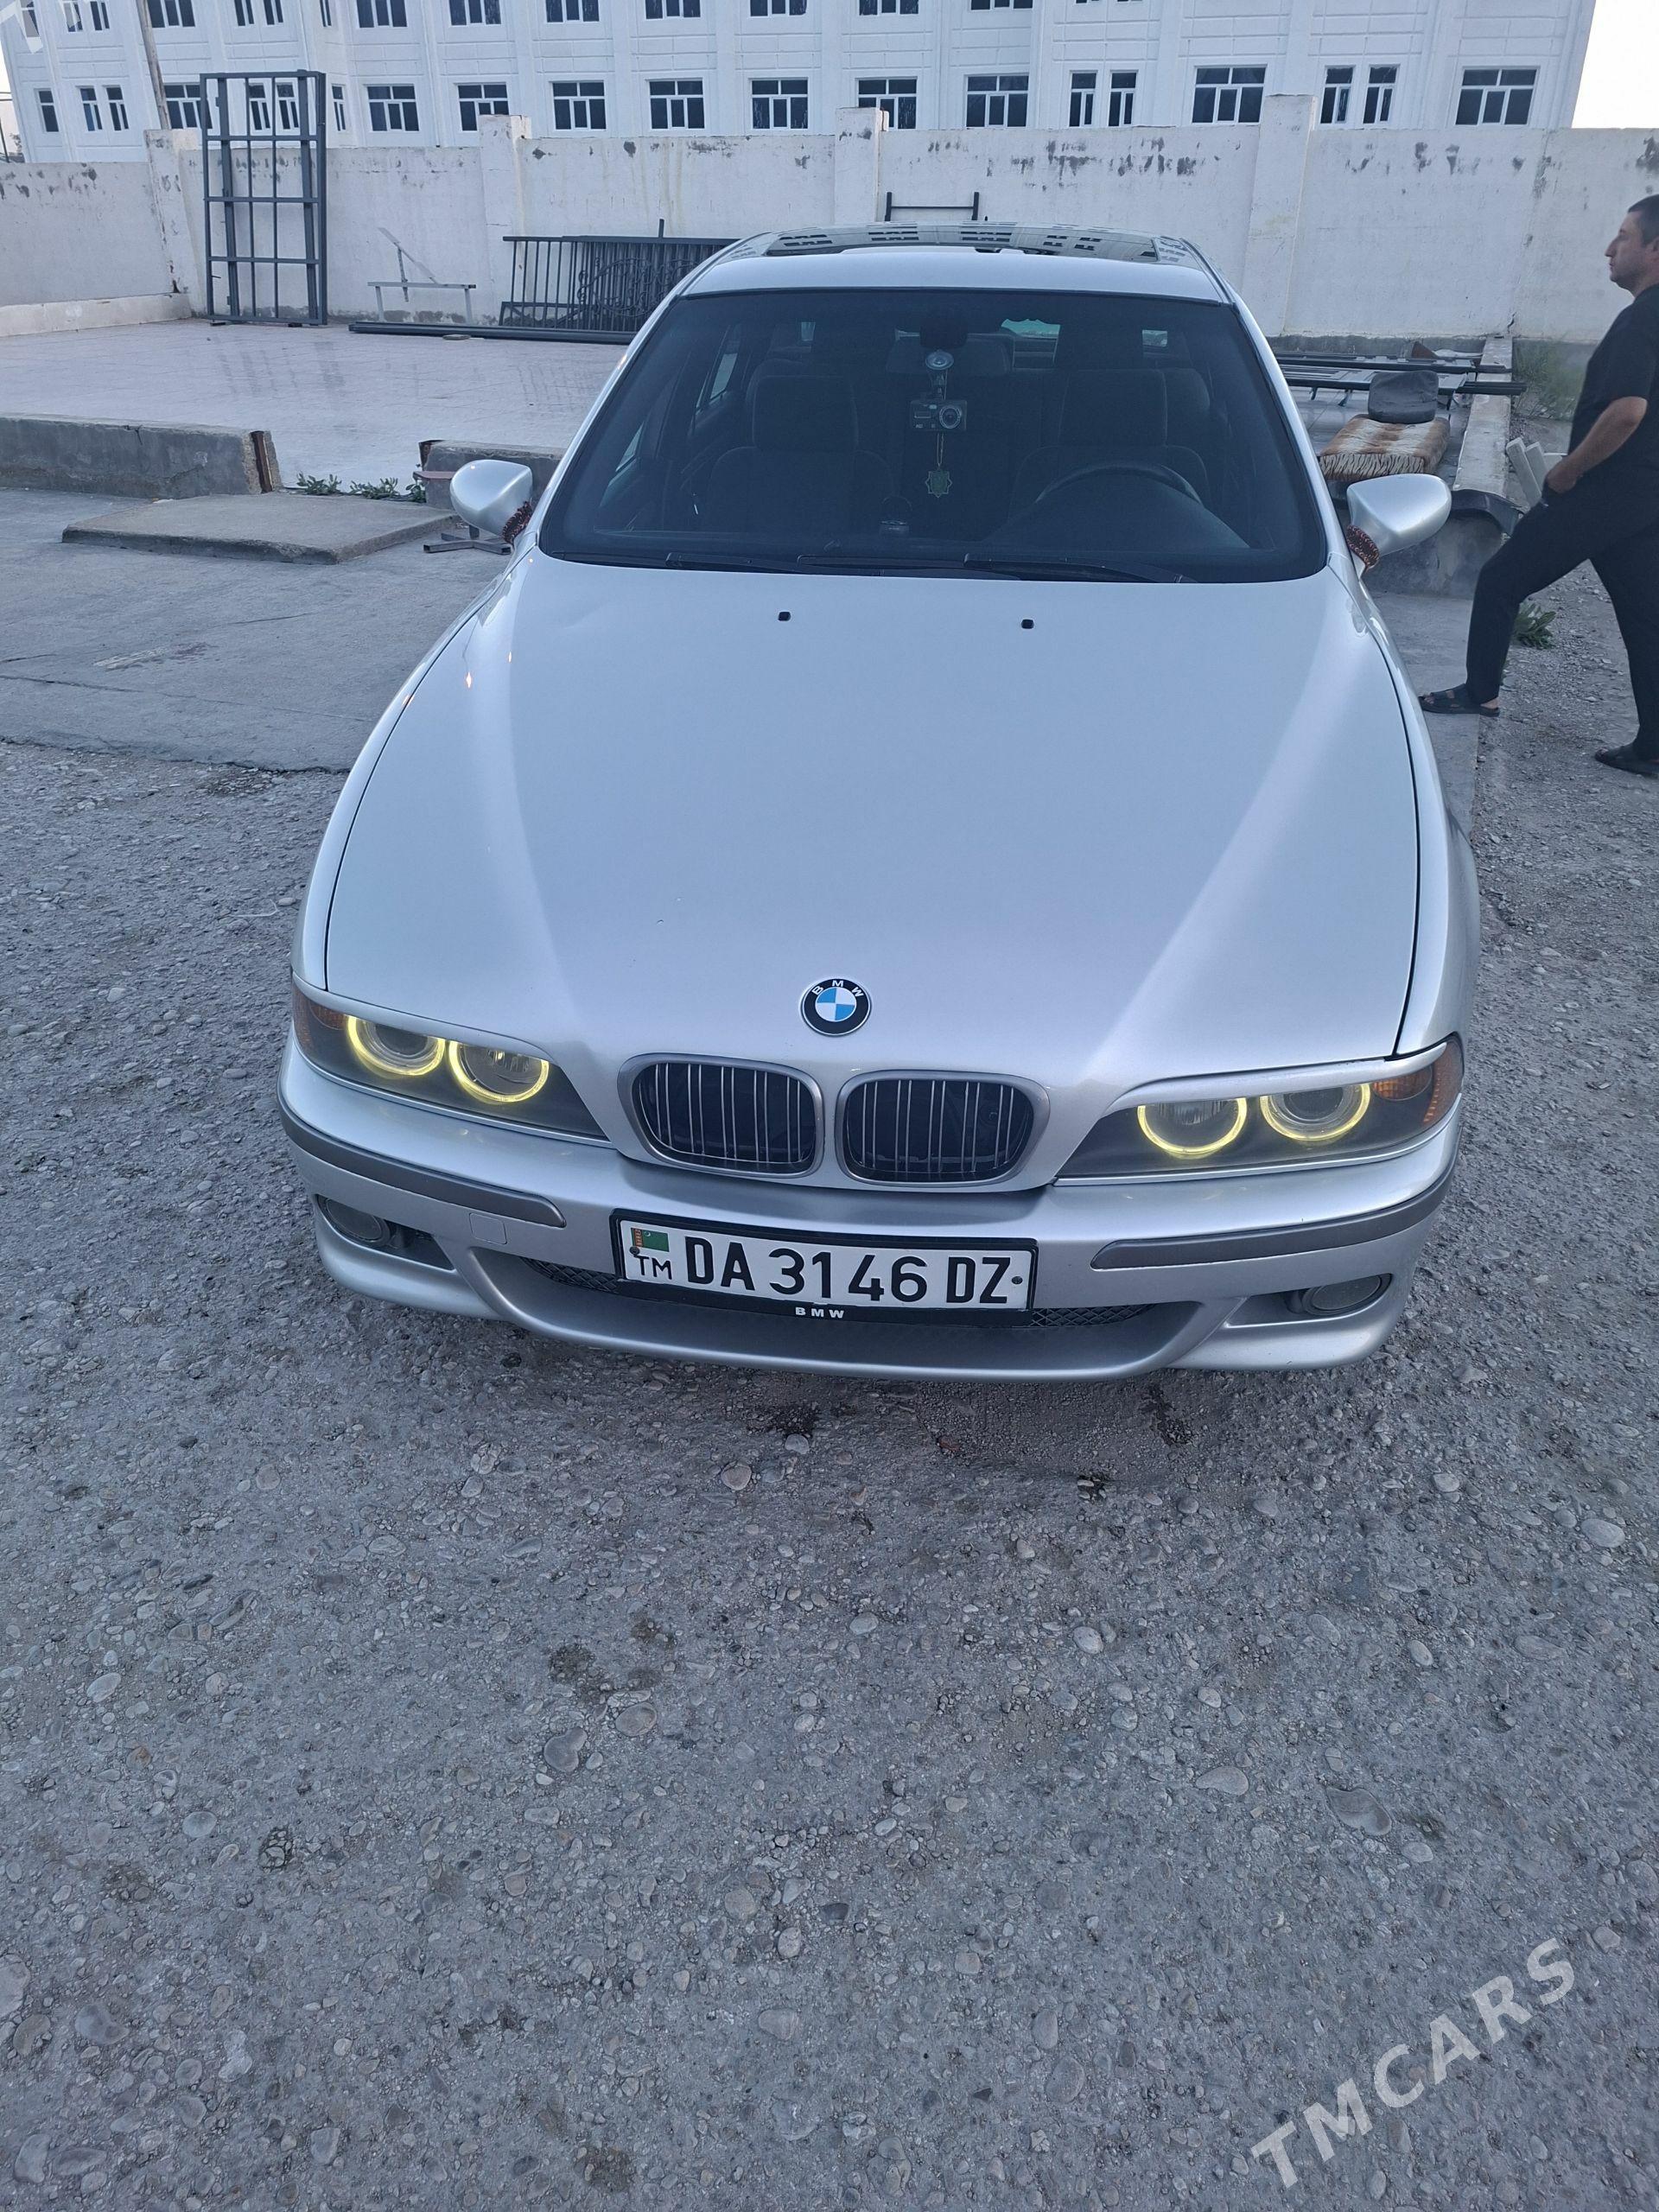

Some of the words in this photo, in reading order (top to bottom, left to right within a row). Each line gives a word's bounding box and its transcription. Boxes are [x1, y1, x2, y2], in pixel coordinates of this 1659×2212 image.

[811, 980, 864, 997] BMW
[636, 1255, 672, 1281] TM
[684, 1236, 755, 1291] DA
[768, 1248, 928, 1302] 3146
[945, 1256, 1012, 1304] DZ
[795, 1306, 844, 1319] BMW
